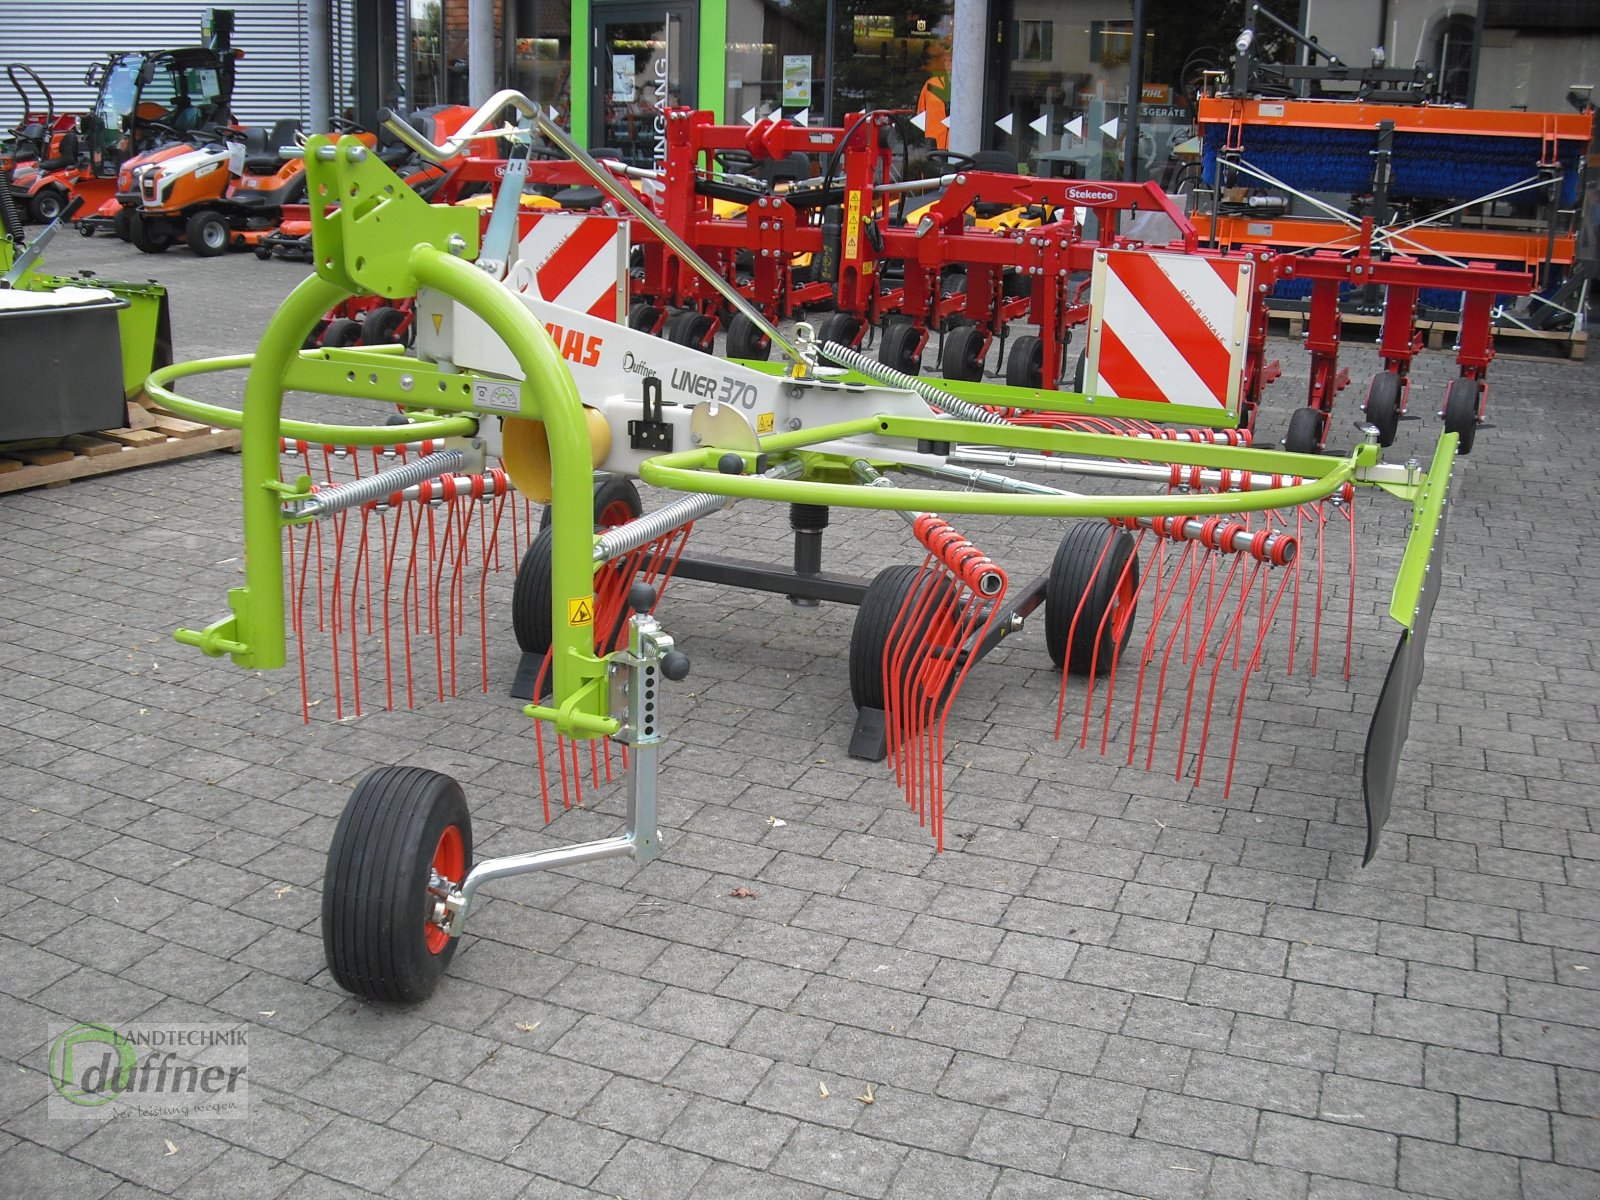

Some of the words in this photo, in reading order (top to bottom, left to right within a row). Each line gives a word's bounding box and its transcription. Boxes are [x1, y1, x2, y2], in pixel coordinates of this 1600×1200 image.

[1141, 89, 1164, 98] TIHL
[1142, 107, 1186, 117] SGERÄTE
[1069, 189, 1113, 200] Steketee
[544, 322, 603, 367] AAS
[623, 351, 657, 378] Duffner
[671, 367, 717, 399] LINER
[718, 376, 758, 410] 370
